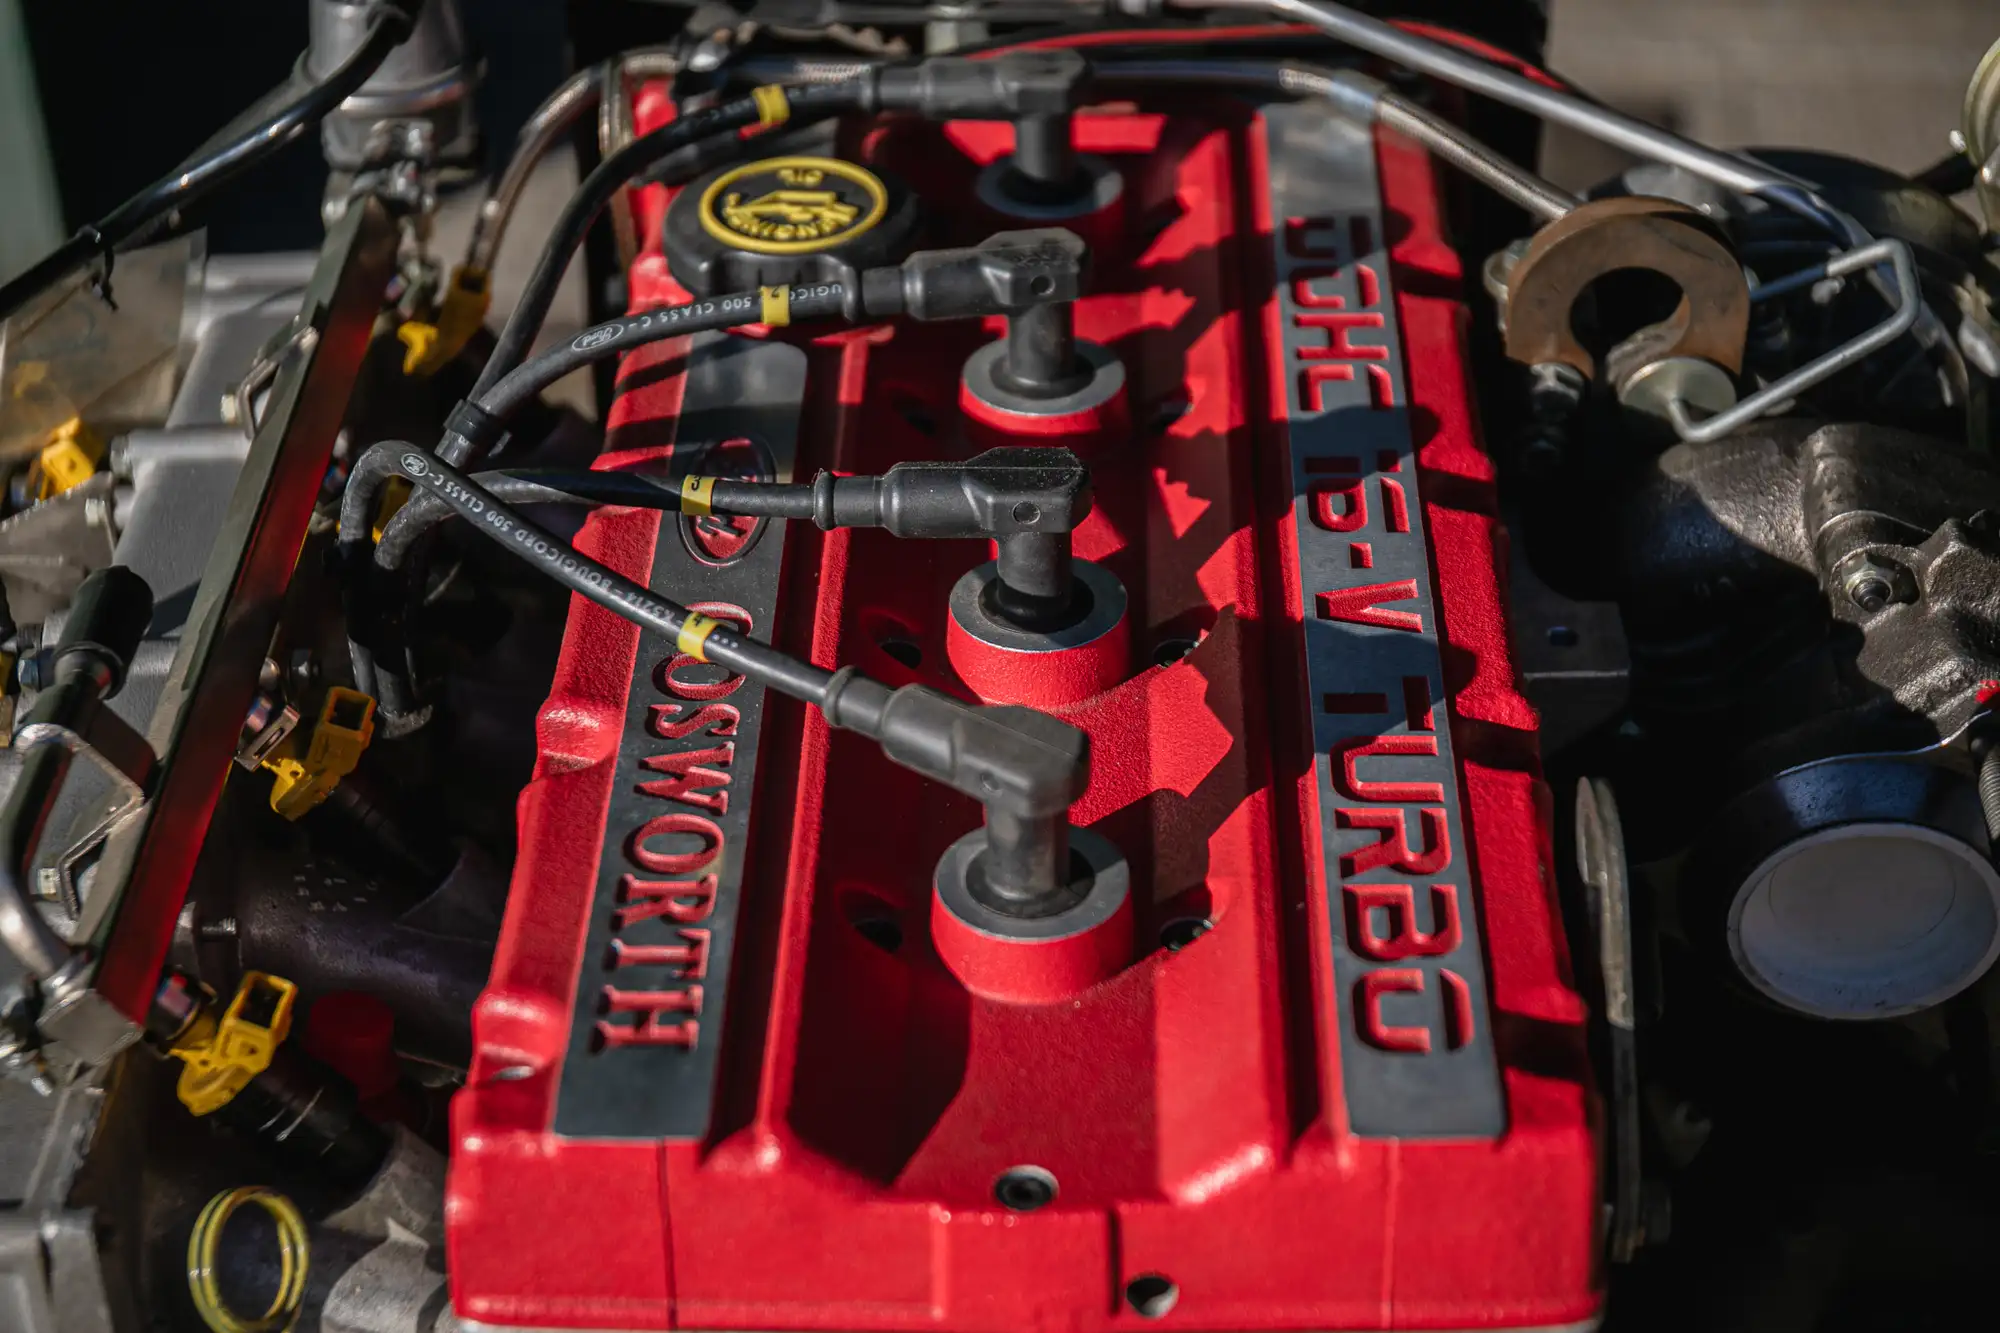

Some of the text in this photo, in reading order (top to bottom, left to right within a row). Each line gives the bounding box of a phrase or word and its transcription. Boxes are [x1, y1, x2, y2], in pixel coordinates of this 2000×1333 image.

[659, 302, 714, 323] CLASS
[722, 296, 752, 311] 500
[444, 481, 484, 513] CLASS
[485, 510, 514, 532] 500
[1285, 215, 1475, 1053] DOHC 16-V TURBO
